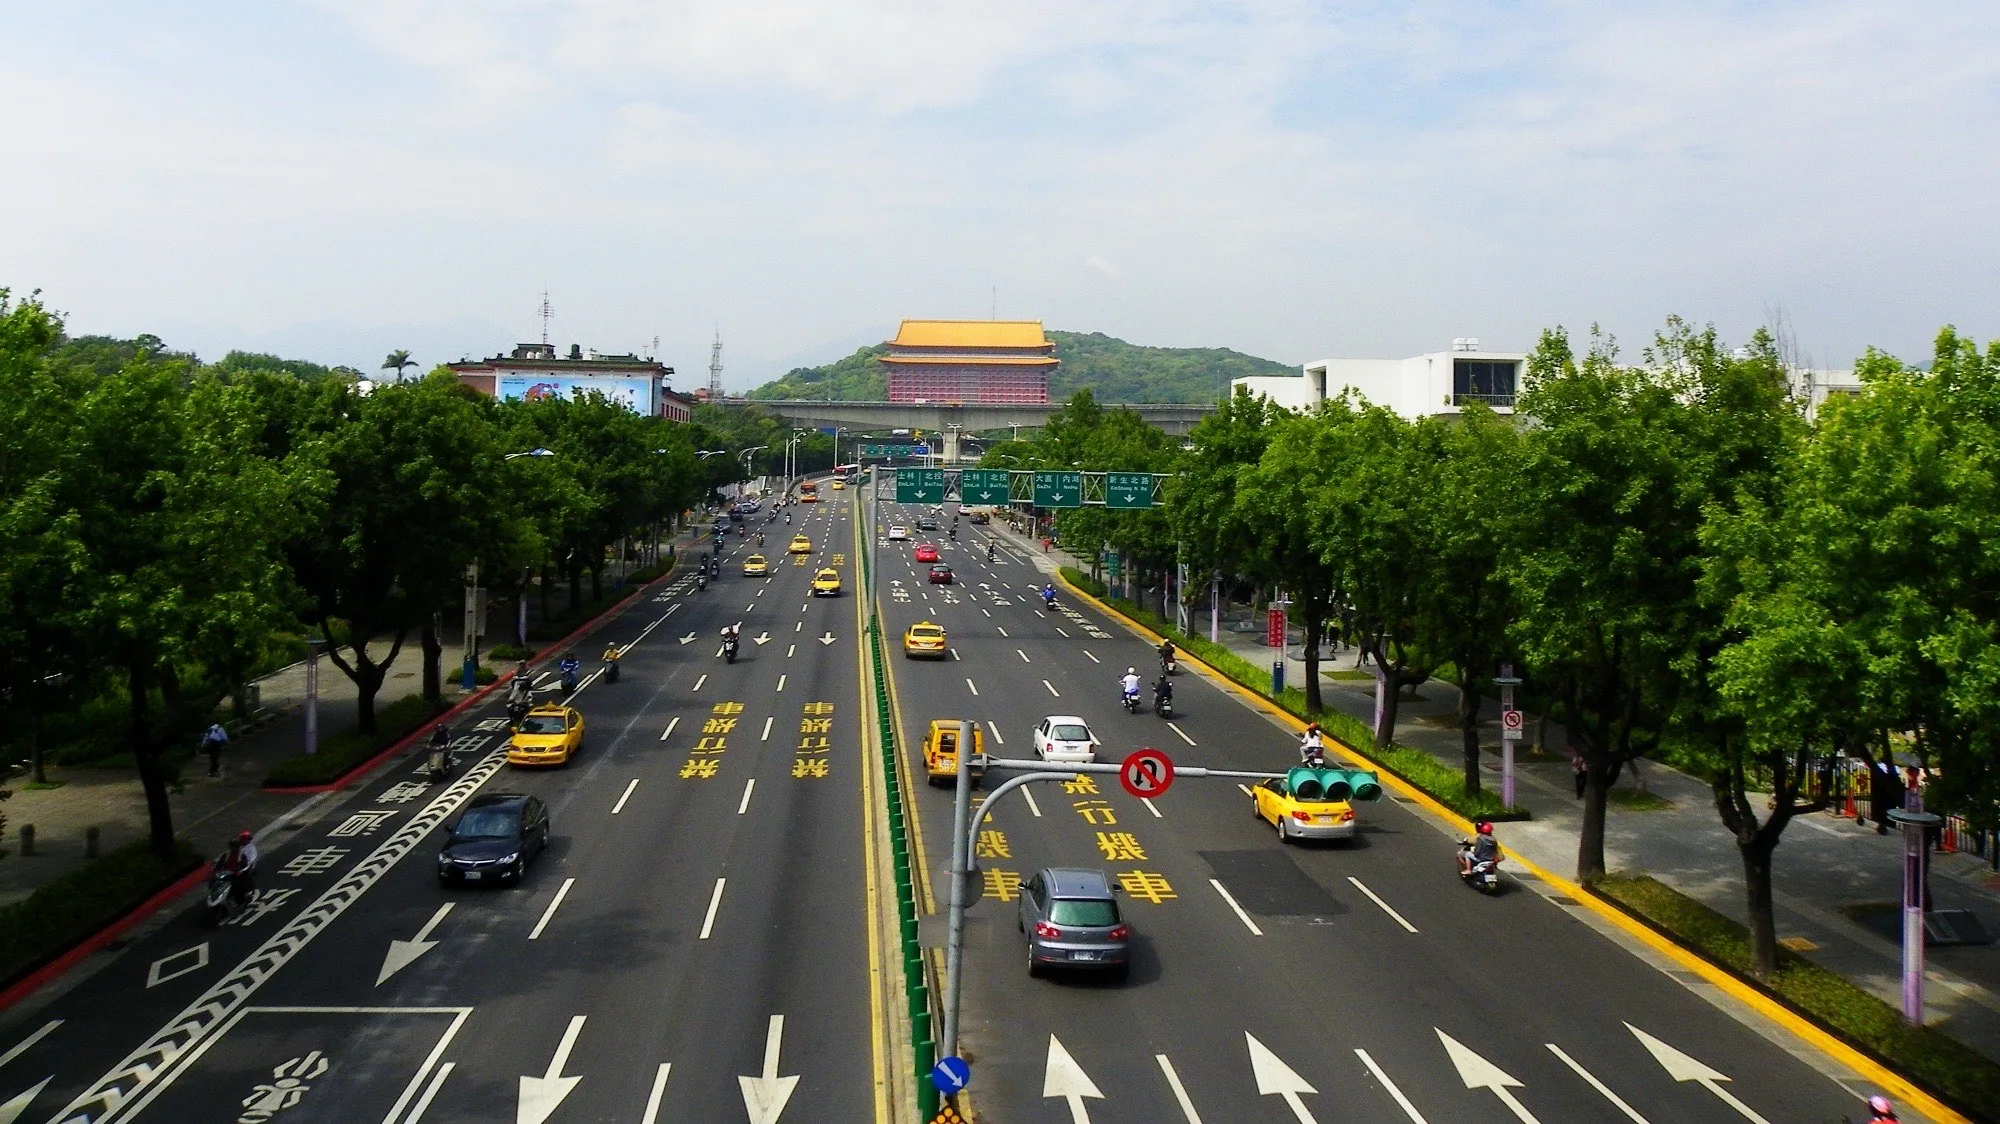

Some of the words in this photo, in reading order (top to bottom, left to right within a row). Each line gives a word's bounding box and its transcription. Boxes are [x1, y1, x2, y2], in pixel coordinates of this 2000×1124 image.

[898, 471, 915, 480] 士林
[925, 471, 942, 480] 北投
[963, 473, 980, 481] 士林
[990, 473, 1008, 481] 北投
[1036, 474, 1052, 483] 大直
[1109, 475, 1149, 485] 新生北路
